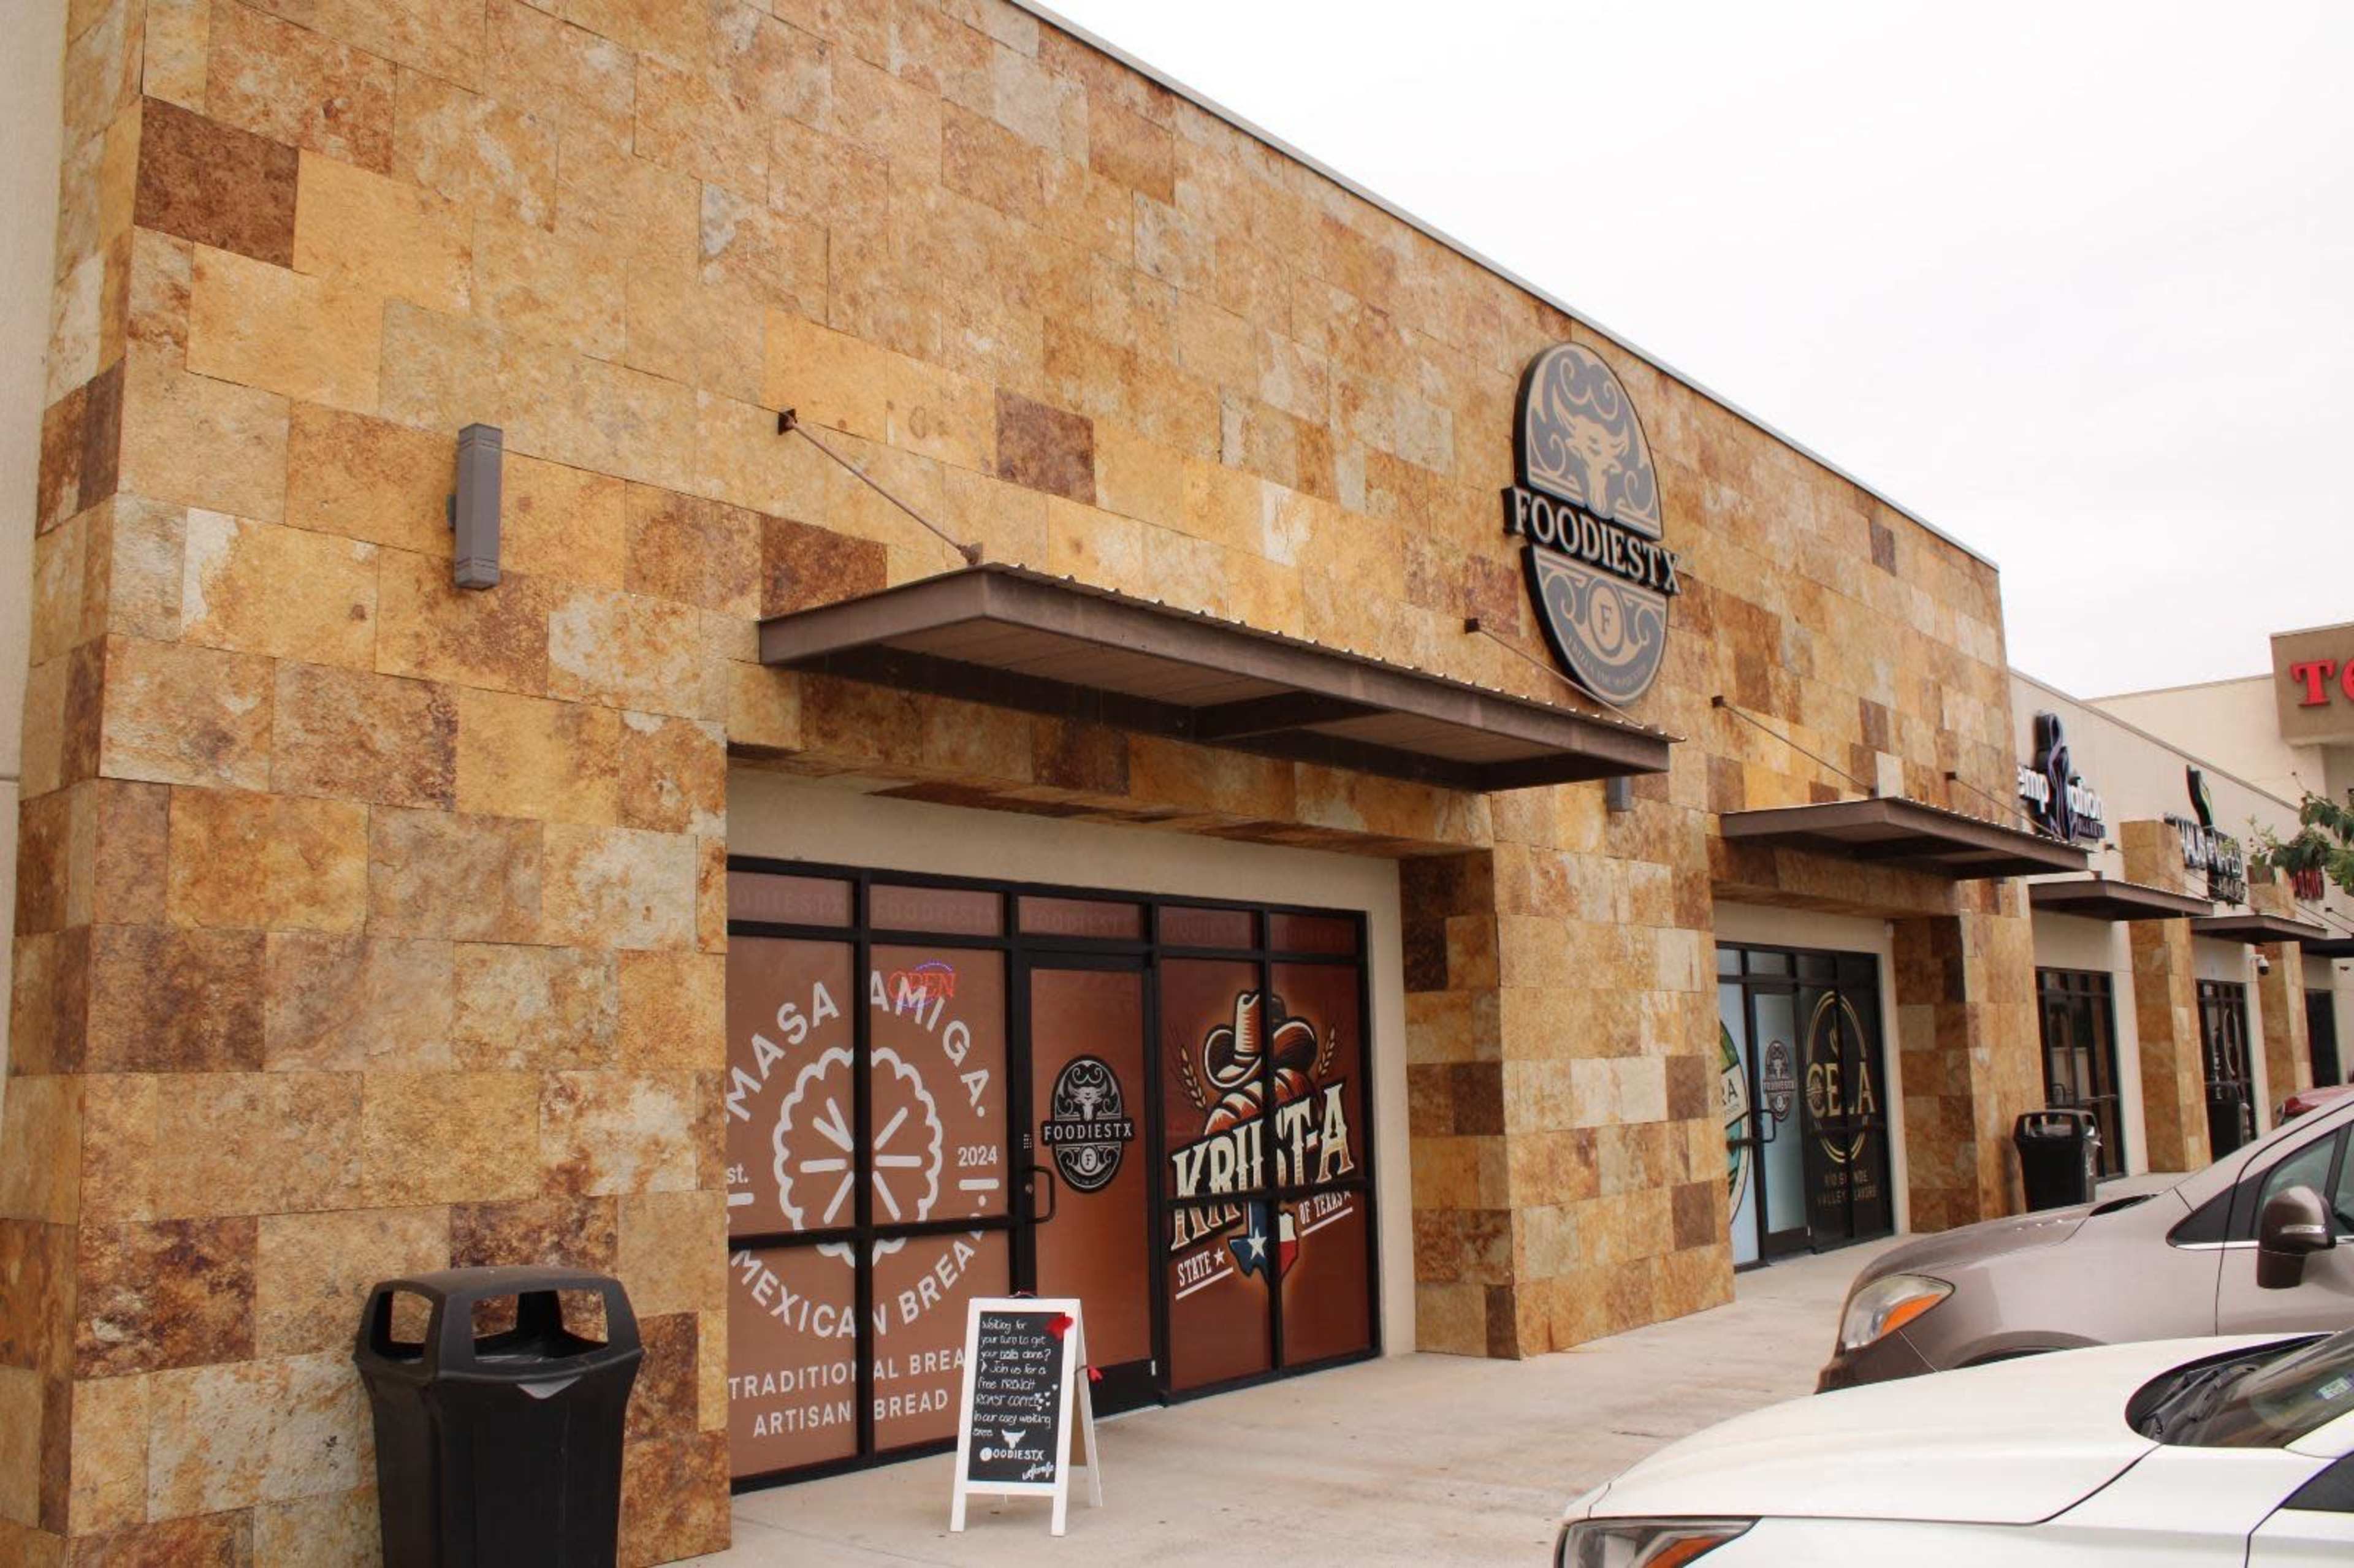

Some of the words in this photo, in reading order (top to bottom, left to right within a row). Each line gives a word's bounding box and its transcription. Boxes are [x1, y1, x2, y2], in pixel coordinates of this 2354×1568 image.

[1514, 487, 1680, 595] FOODIESTX
[1600, 604, 1612, 635] F
[2289, 658, 2354, 707] T
[888, 970, 956, 999] OPEN
[726, 981, 840, 1122] MASA
[1806, 1062, 1876, 1119] CEA
[1044, 1123, 1132, 1141] FOODIESTX
[959, 1145, 997, 1166] 2024
[726, 1164, 748, 1184] st.
[1177, 1249, 1212, 1287] STATE
[1016, 1319, 1027, 1330] for
[980, 1336, 999, 1349] your
[1019, 1335, 1029, 1345] to
[1030, 1335, 1046, 1348] get
[909, 1348, 966, 1376] BREA
[990, 1360, 1009, 1374] Join
[1024, 1363, 1037, 1374] for
[1038, 1366, 1047, 1375] a
[753, 1400, 851, 1439] ARTISAN
[874, 1389, 948, 1421] BREAD
[980, 1447, 1045, 1461] OODIESTX
